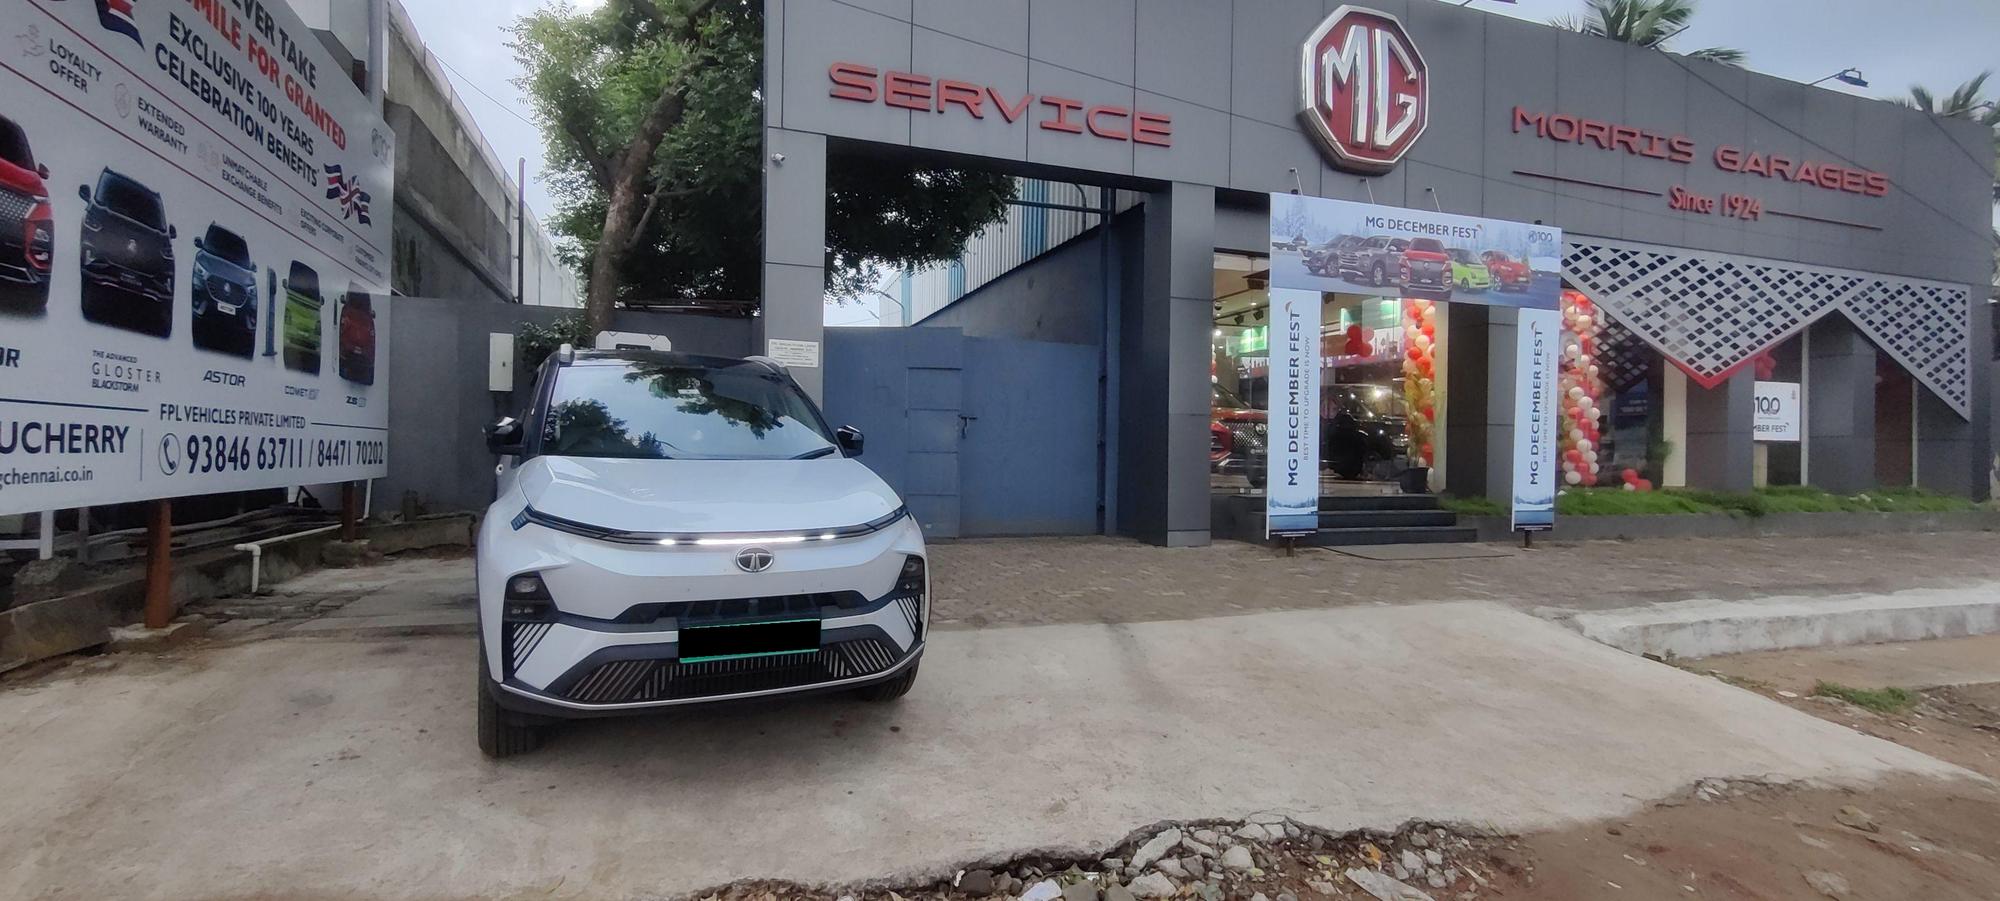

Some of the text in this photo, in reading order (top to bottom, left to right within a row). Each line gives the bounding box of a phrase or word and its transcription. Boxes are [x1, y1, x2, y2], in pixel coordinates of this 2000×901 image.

[50, 38, 101, 82] LOYALTY
[50, 60, 88, 93] OFFER
[279, 27, 316, 90] TAKE
[155, 43, 263, 146] CELEBRATION
[169, 12, 314, 156] EXCLUSIVE 100 YEARS
[248, 33, 280, 88] FOR
[285, 73, 346, 150] GRANTED
[1321, 25, 1417, 149] MG
[138, 97, 185, 136] EXTENDED
[829, 62, 1171, 148] SERVICE
[138, 115, 188, 155] WARRANTY
[1512, 105, 1889, 197] MORRIS GARAGES
[222, 153, 267, 191] UNMATCHABLE
[222, 169, 256, 199] EXCHANGE
[1669, 184, 1761, 221] Since 1924
[1366, 216, 1479, 239] MG DECEMBER FEST
[92, 362, 161, 383] GLOSTER
[203, 370, 246, 387] ASTOR
[1304, 359, 1310, 367] IS
[92, 378, 139, 393] BLACKSTORM
[1288, 311, 1301, 486] MG DECEMBER FEST
[160, 403, 306, 429] FPL VEHICLES PRIVATE LIMITED
[1303, 409, 1309, 420] TO
[1530, 329, 1543, 485] MG DECEMBER FEST
[1755, 396, 1780, 415] 100
[1771, 424, 1787, 433] FEST
[187, 434, 250, 474] 93846
[257, 436, 303, 470] 63711
[317, 439, 351, 467] 84471
[356, 440, 384, 465] 70202
